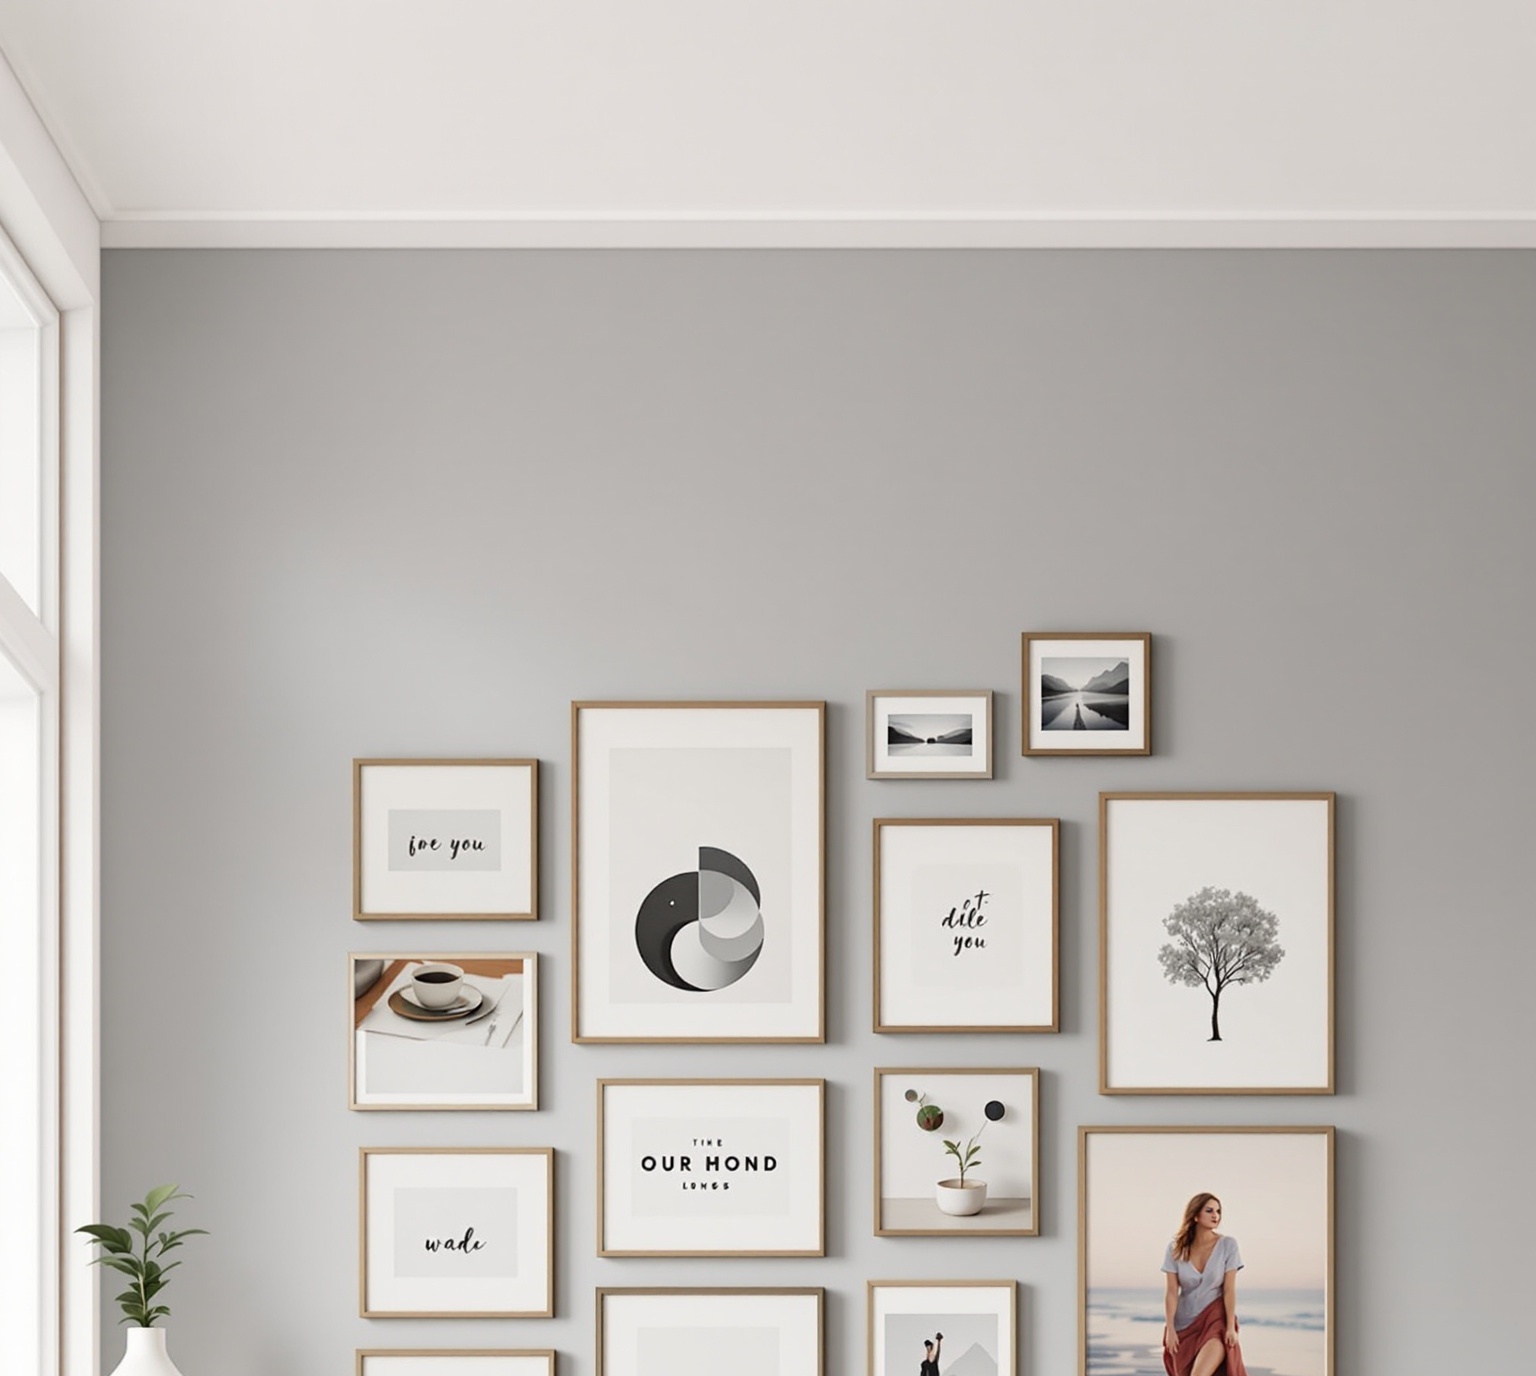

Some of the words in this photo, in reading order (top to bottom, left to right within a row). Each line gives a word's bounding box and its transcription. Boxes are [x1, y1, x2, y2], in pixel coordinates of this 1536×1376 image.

[449, 838, 486, 861] you
[953, 936, 987, 957] you
[640, 1155, 692, 1172] OUR
[705, 1155, 778, 1172] HOND
